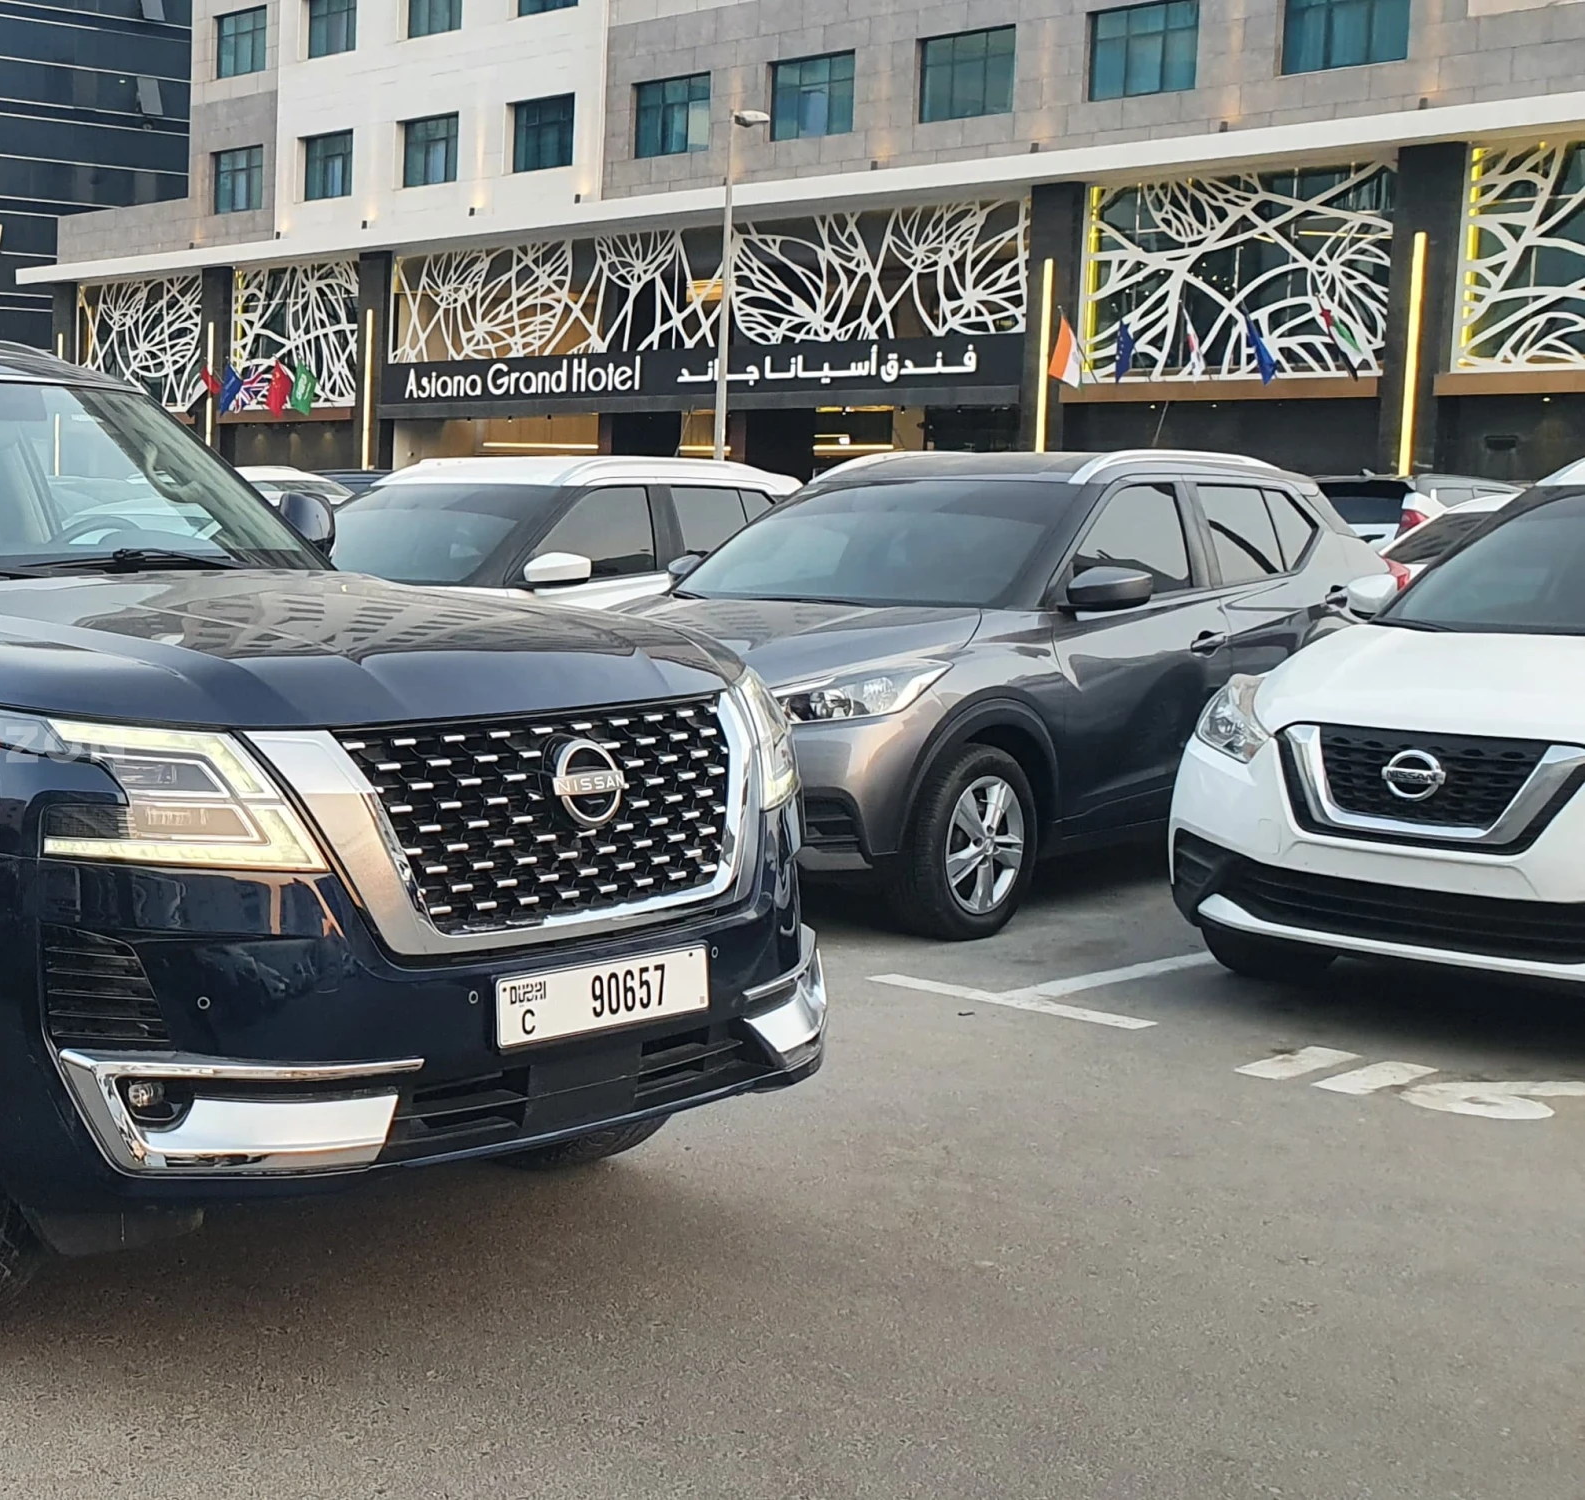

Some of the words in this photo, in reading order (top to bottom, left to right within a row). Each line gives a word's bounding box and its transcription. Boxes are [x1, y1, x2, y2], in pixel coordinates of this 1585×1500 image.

[404, 368, 483, 399] Asiana
[486, 358, 569, 396] Grand
[572, 355, 641, 393] Hotel
[880, 343, 978, 383] فندق
[555, 774, 626, 794] NISSAN
[1387, 770, 1438, 782] NISSAN
[591, 963, 666, 1018] 90657
[521, 1008, 536, 1035] C
